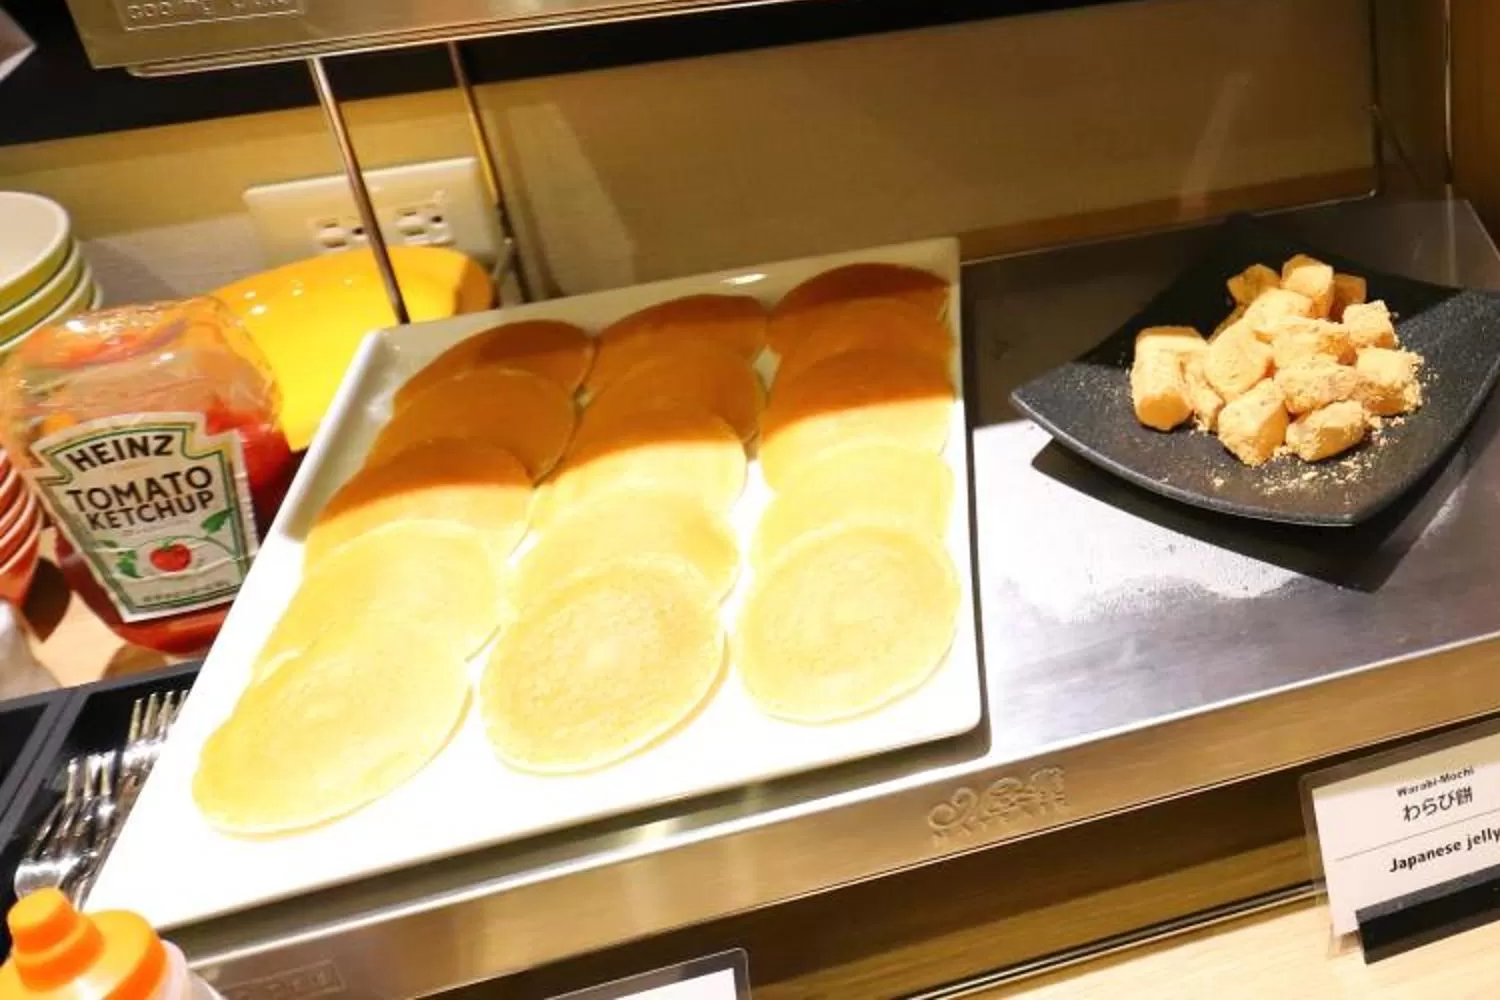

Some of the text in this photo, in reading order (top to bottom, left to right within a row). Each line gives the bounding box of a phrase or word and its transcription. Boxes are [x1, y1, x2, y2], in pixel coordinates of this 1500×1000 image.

[66, 434, 175, 472] HEINZ
[65, 465, 214, 514] TOMATO
[85, 490, 215, 531] KETCHUP
[1396, 766, 1475, 797] Warabi-Mochi
[1402, 785, 1473, 822] わらび餅
[1389, 827, 1500, 873] Japanese jelly
